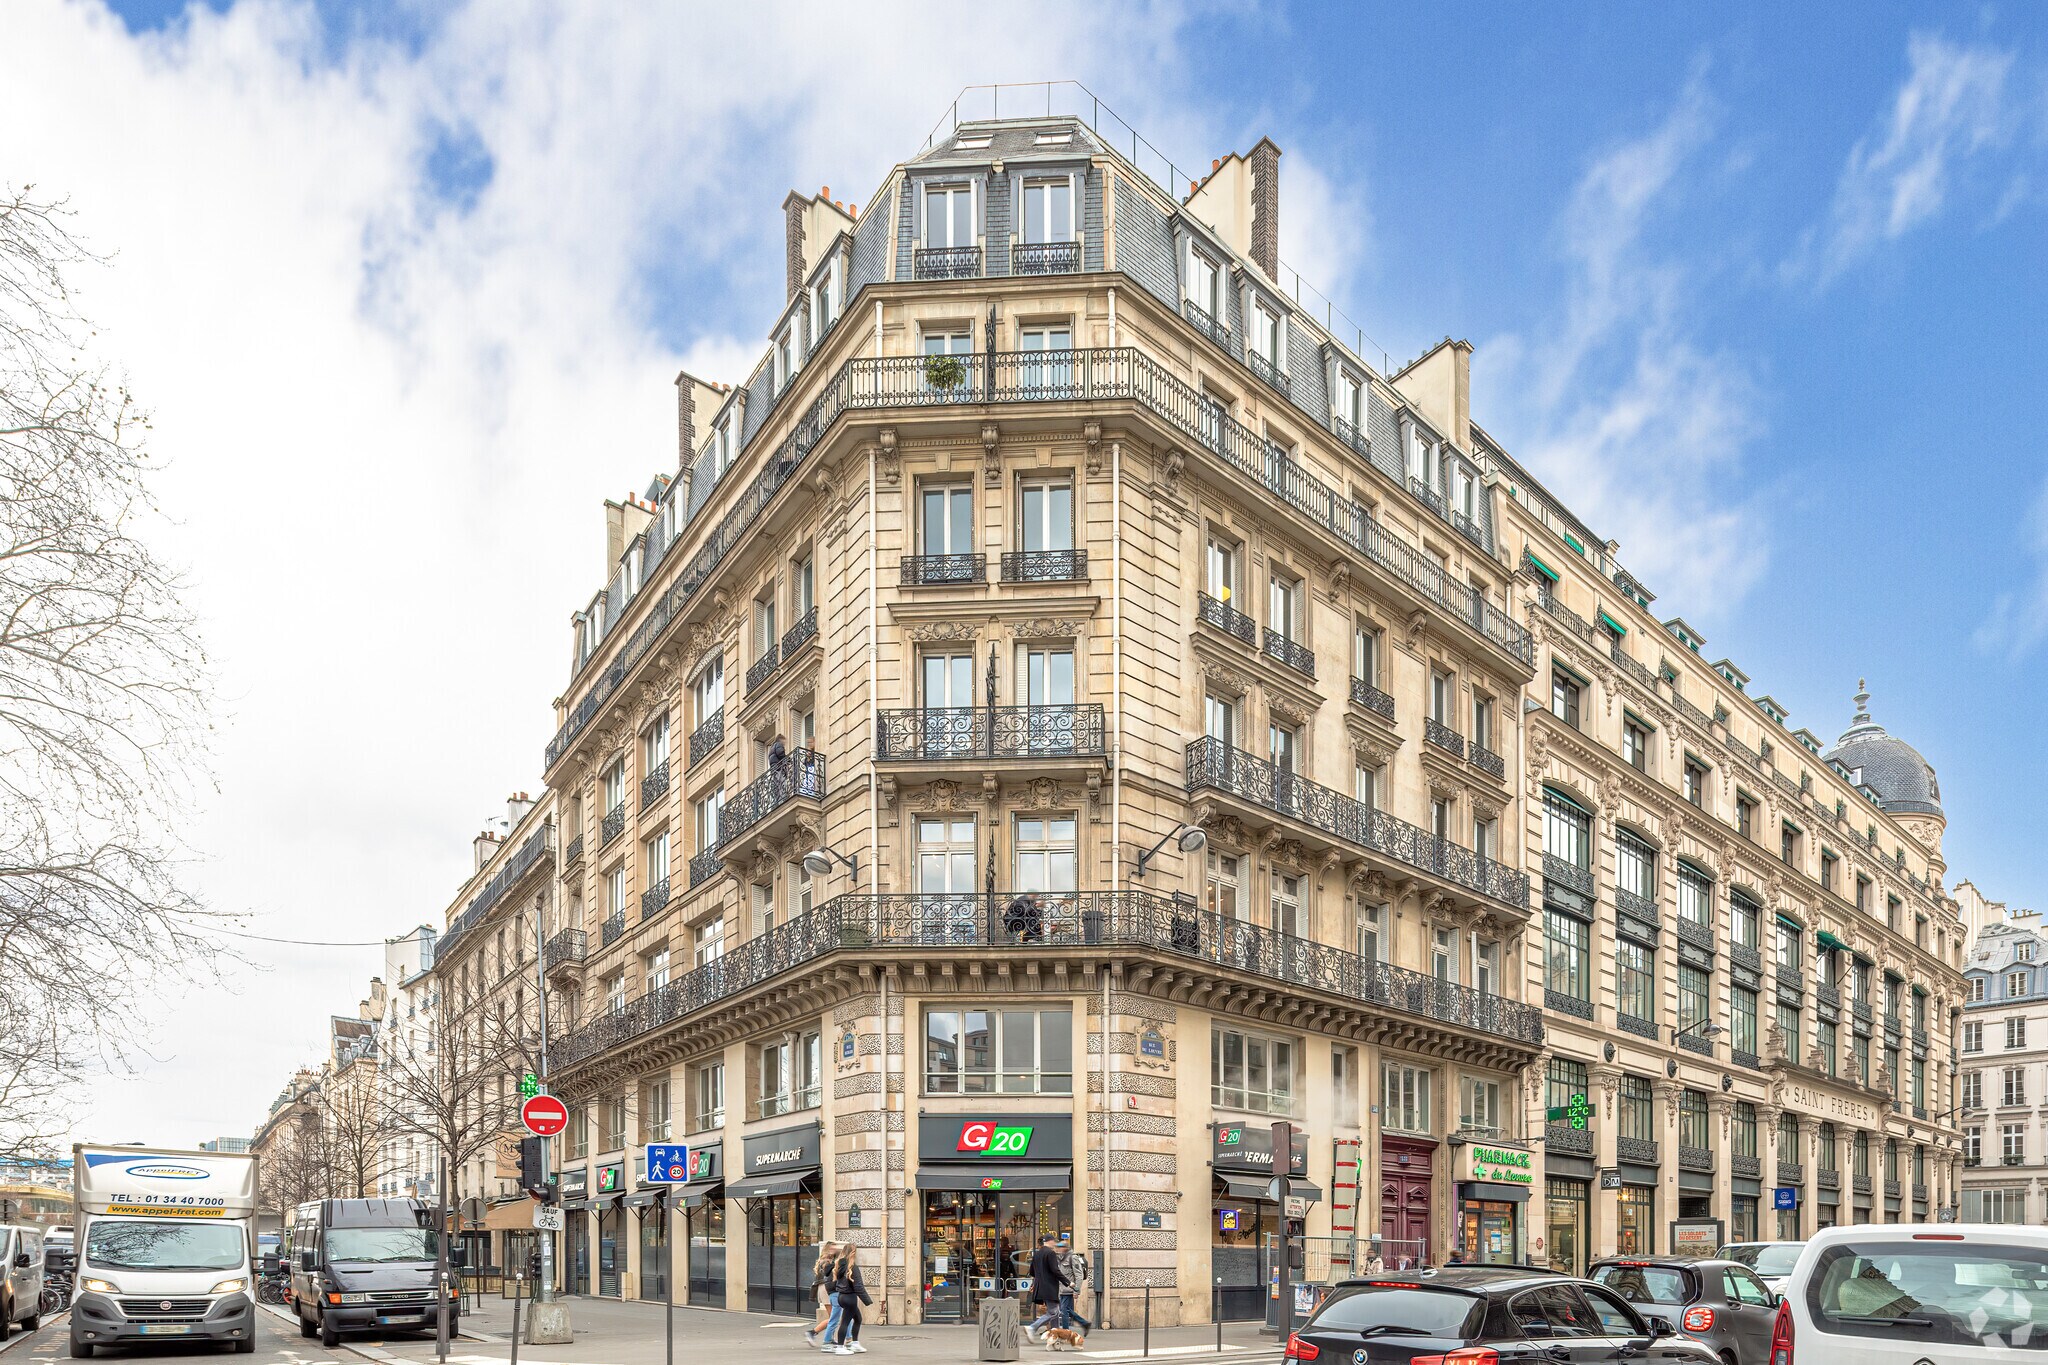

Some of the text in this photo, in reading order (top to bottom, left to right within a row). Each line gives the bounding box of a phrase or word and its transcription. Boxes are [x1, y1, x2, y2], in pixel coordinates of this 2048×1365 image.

[1793, 1086, 1825, 1110] SAINT
[1567, 1106, 1589, 1117] 12°C
[963, 1124, 1026, 1151] G20
[1220, 1130, 1239, 1143] G20
[755, 1146, 802, 1167] SUPERMARCHÉ
[689, 1154, 709, 1174] G20
[982, 1179, 1001, 1188] G20
[110, 1194, 133, 1203] TEL
[145, 1195, 159, 1204] 01
[163, 1195, 177, 1205] 34
[181, 1196, 195, 1205] 40
[198, 1197, 225, 1206] 7000
[111, 1206, 222, 1217] www.appel-fret.com
[541, 1206, 558, 1215] SAUF
